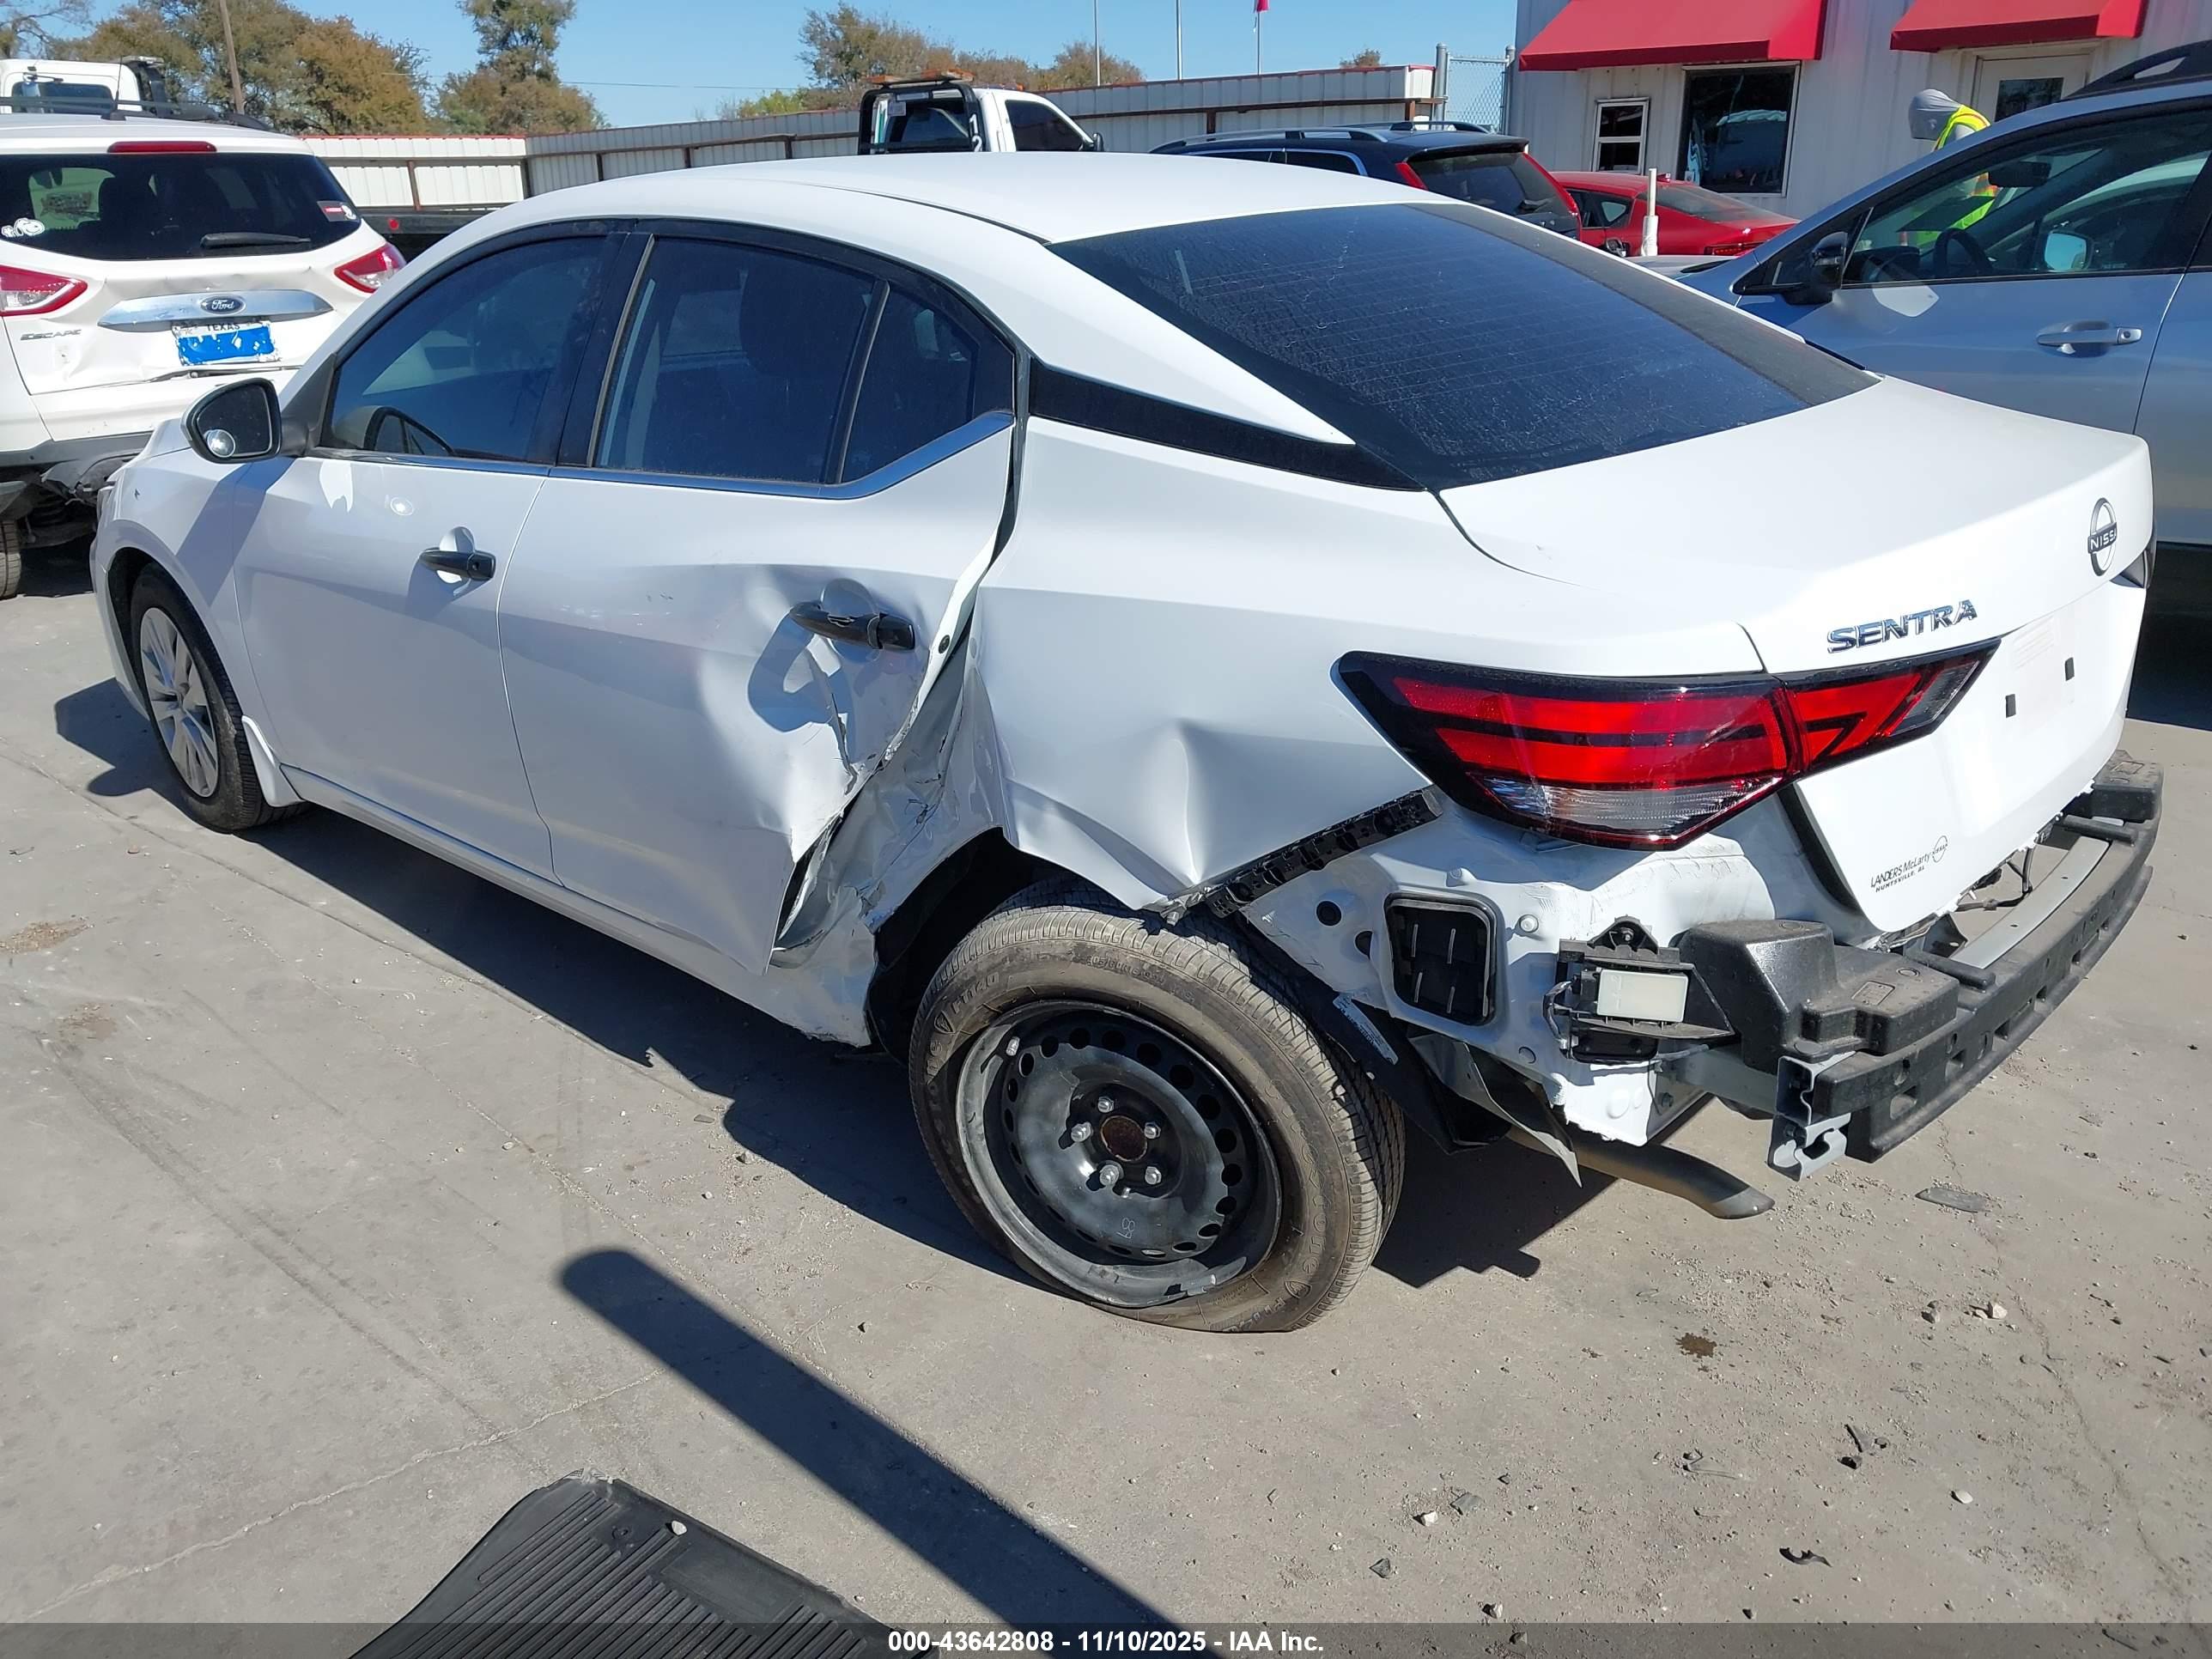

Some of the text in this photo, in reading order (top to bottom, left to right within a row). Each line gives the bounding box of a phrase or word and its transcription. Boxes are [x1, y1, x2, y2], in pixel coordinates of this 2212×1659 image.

[211, 299, 235, 310] Ford
[206, 323, 241, 332] TEXAS
[20, 329, 82, 341] ESCAPE
[1826, 599, 1978, 653] SENTRA
[1870, 864, 1903, 888] LANDERS
[1902, 852, 1931, 873] McLarty
